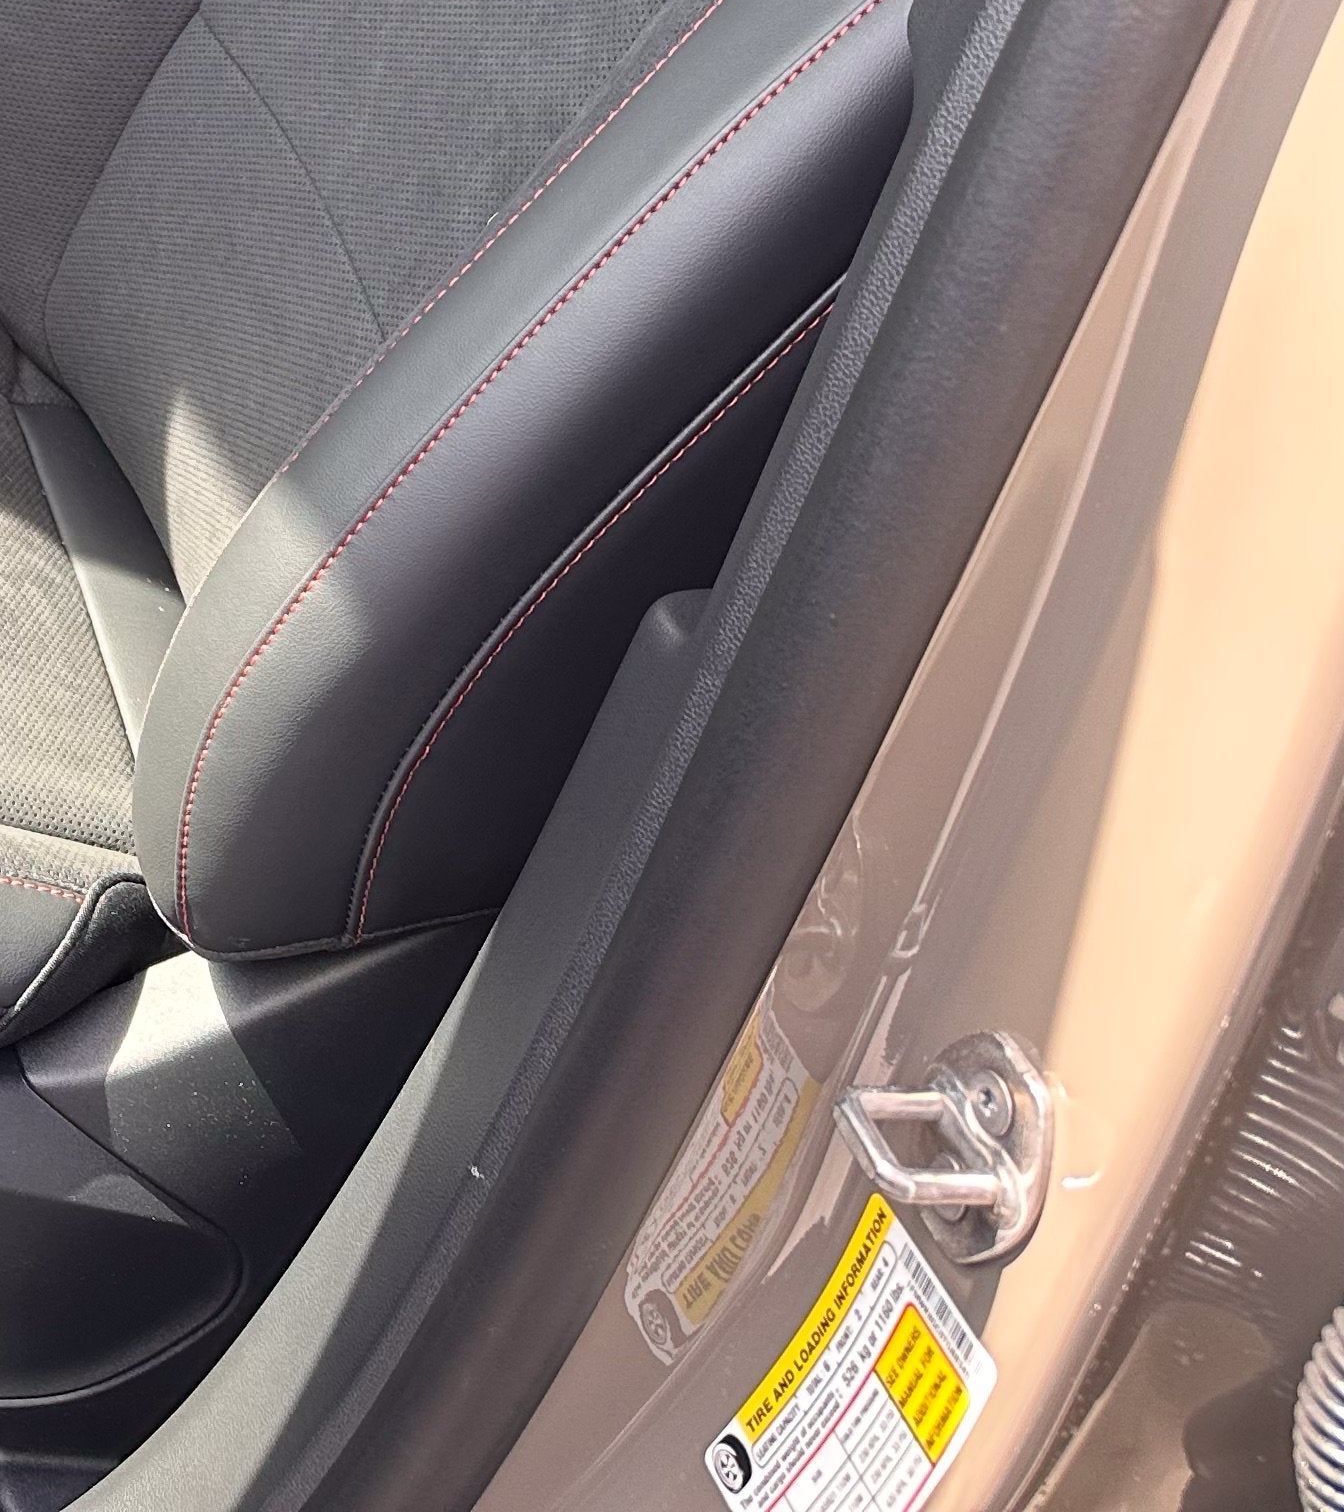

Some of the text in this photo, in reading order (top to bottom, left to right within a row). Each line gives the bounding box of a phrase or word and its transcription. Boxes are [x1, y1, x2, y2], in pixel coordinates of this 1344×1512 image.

[746, 1207, 888, 1433] TIRE AND LOADING INFORMATION
[841, 1359, 859, 1387] 526
[857, 1344, 872, 1362] kg
[868, 1331, 877, 1347] or
[874, 1299, 893, 1331] 1160
[885, 1366, 899, 1388] SEE
[899, 1345, 935, 1408] MANUAL FOR
